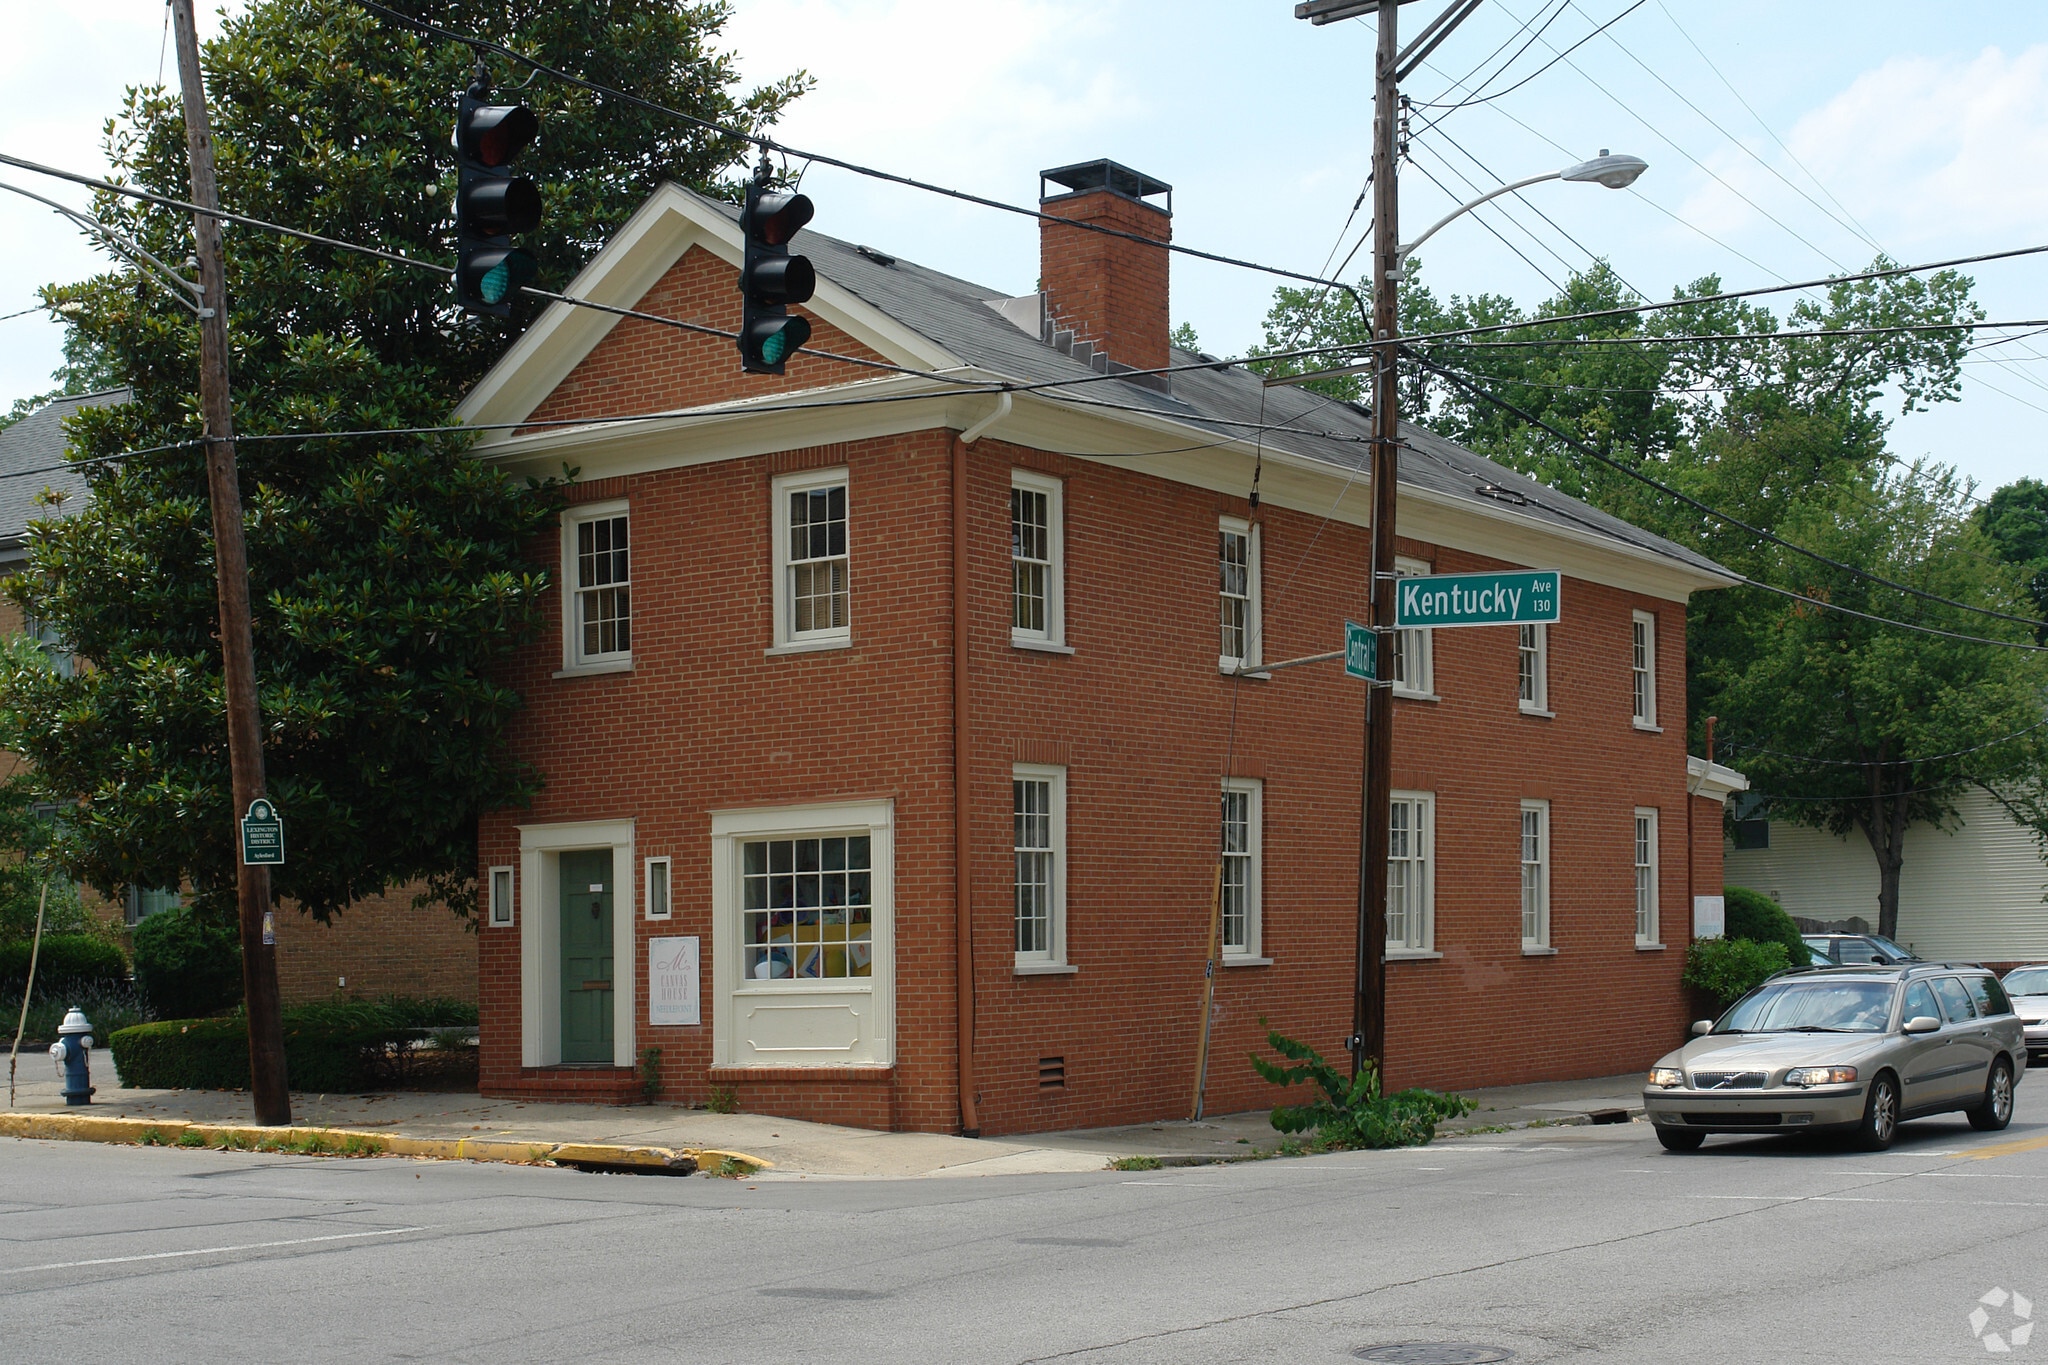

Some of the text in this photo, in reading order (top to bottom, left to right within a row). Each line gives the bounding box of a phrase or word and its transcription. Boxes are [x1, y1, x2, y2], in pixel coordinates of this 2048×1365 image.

[1403, 579, 1551, 620] Kentucky Ave
[1533, 599, 1551, 612] 130
[1347, 629, 1370, 672] Central
[660, 974, 688, 988] CANVAS
[661, 987, 688, 1000] HOUSE
[656, 1004, 692, 1014] NEEDLEPOINT
